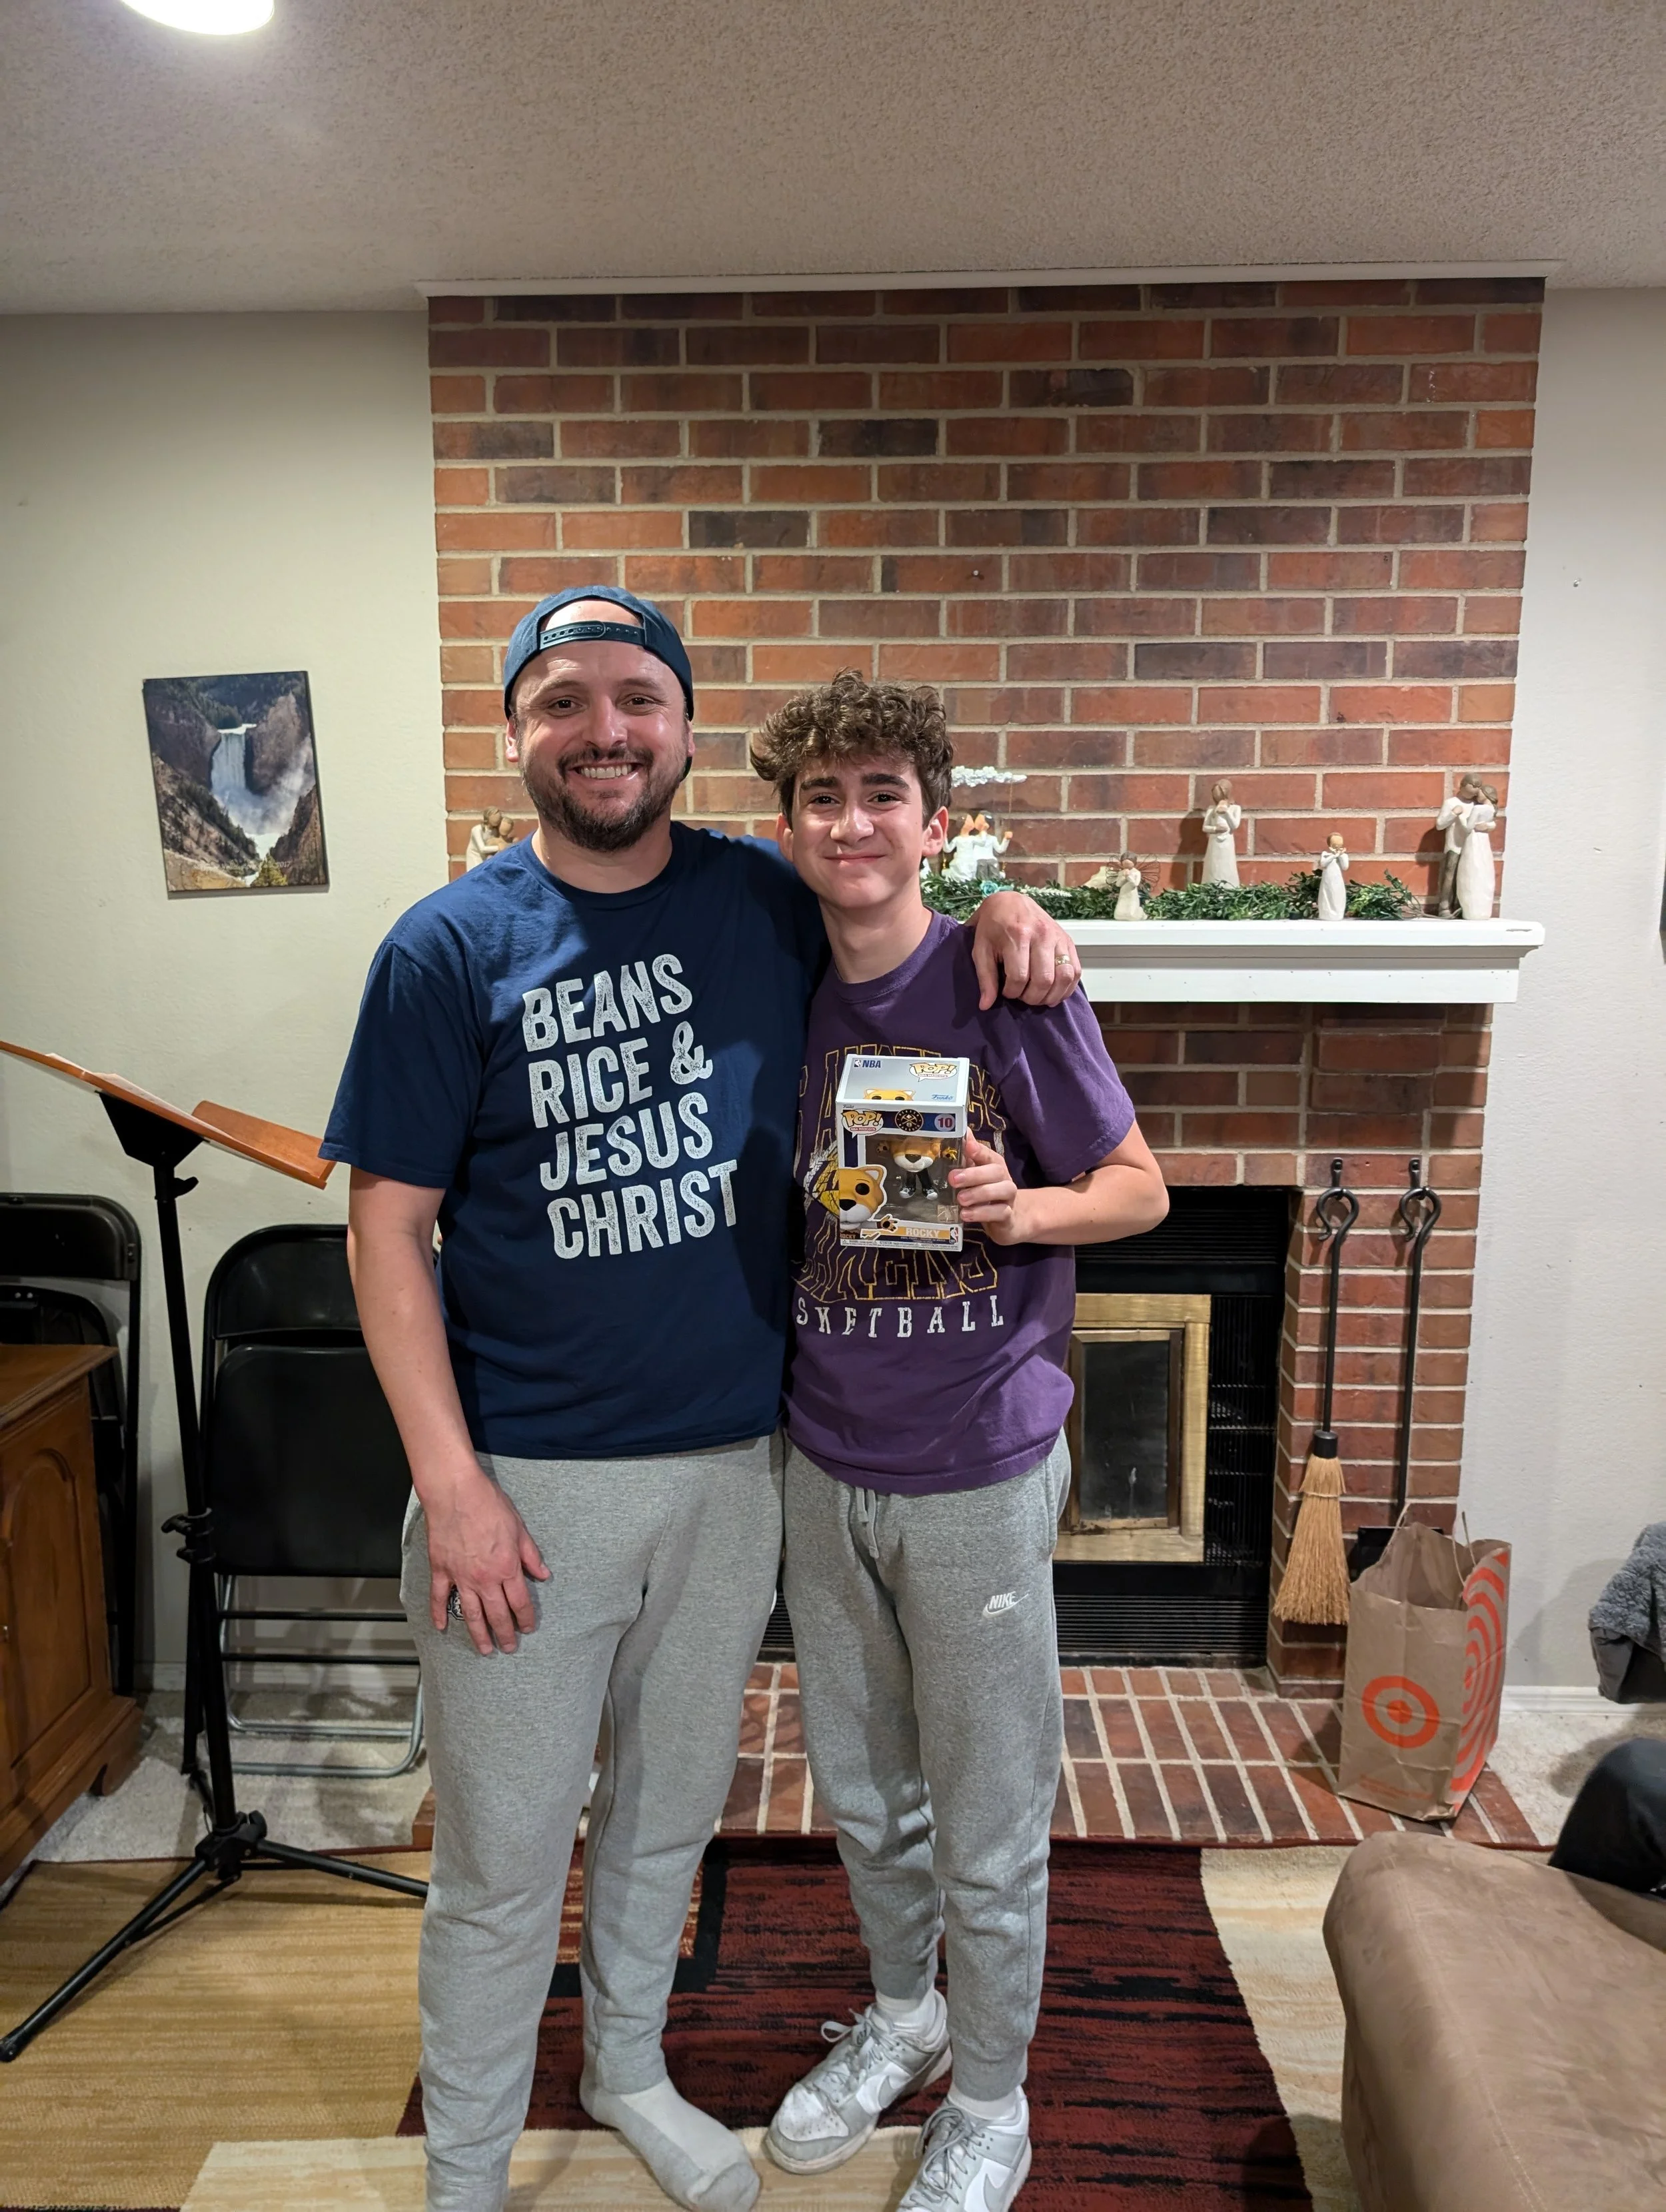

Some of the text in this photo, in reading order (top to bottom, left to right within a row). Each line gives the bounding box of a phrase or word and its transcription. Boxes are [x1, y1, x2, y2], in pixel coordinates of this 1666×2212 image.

[522, 953, 693, 1052] BEANS
[528, 1021, 713, 1129] RICE &
[910, 1062, 957, 1074] POP!
[841, 1109, 882, 1127] POP!
[938, 1118, 954, 1128] 10
[540, 1091, 713, 1191] JESUS
[547, 1159, 738, 1259] CHRIST
[906, 1227, 940, 1239] ROCKY
[988, 1590, 1016, 1610] NIKE
